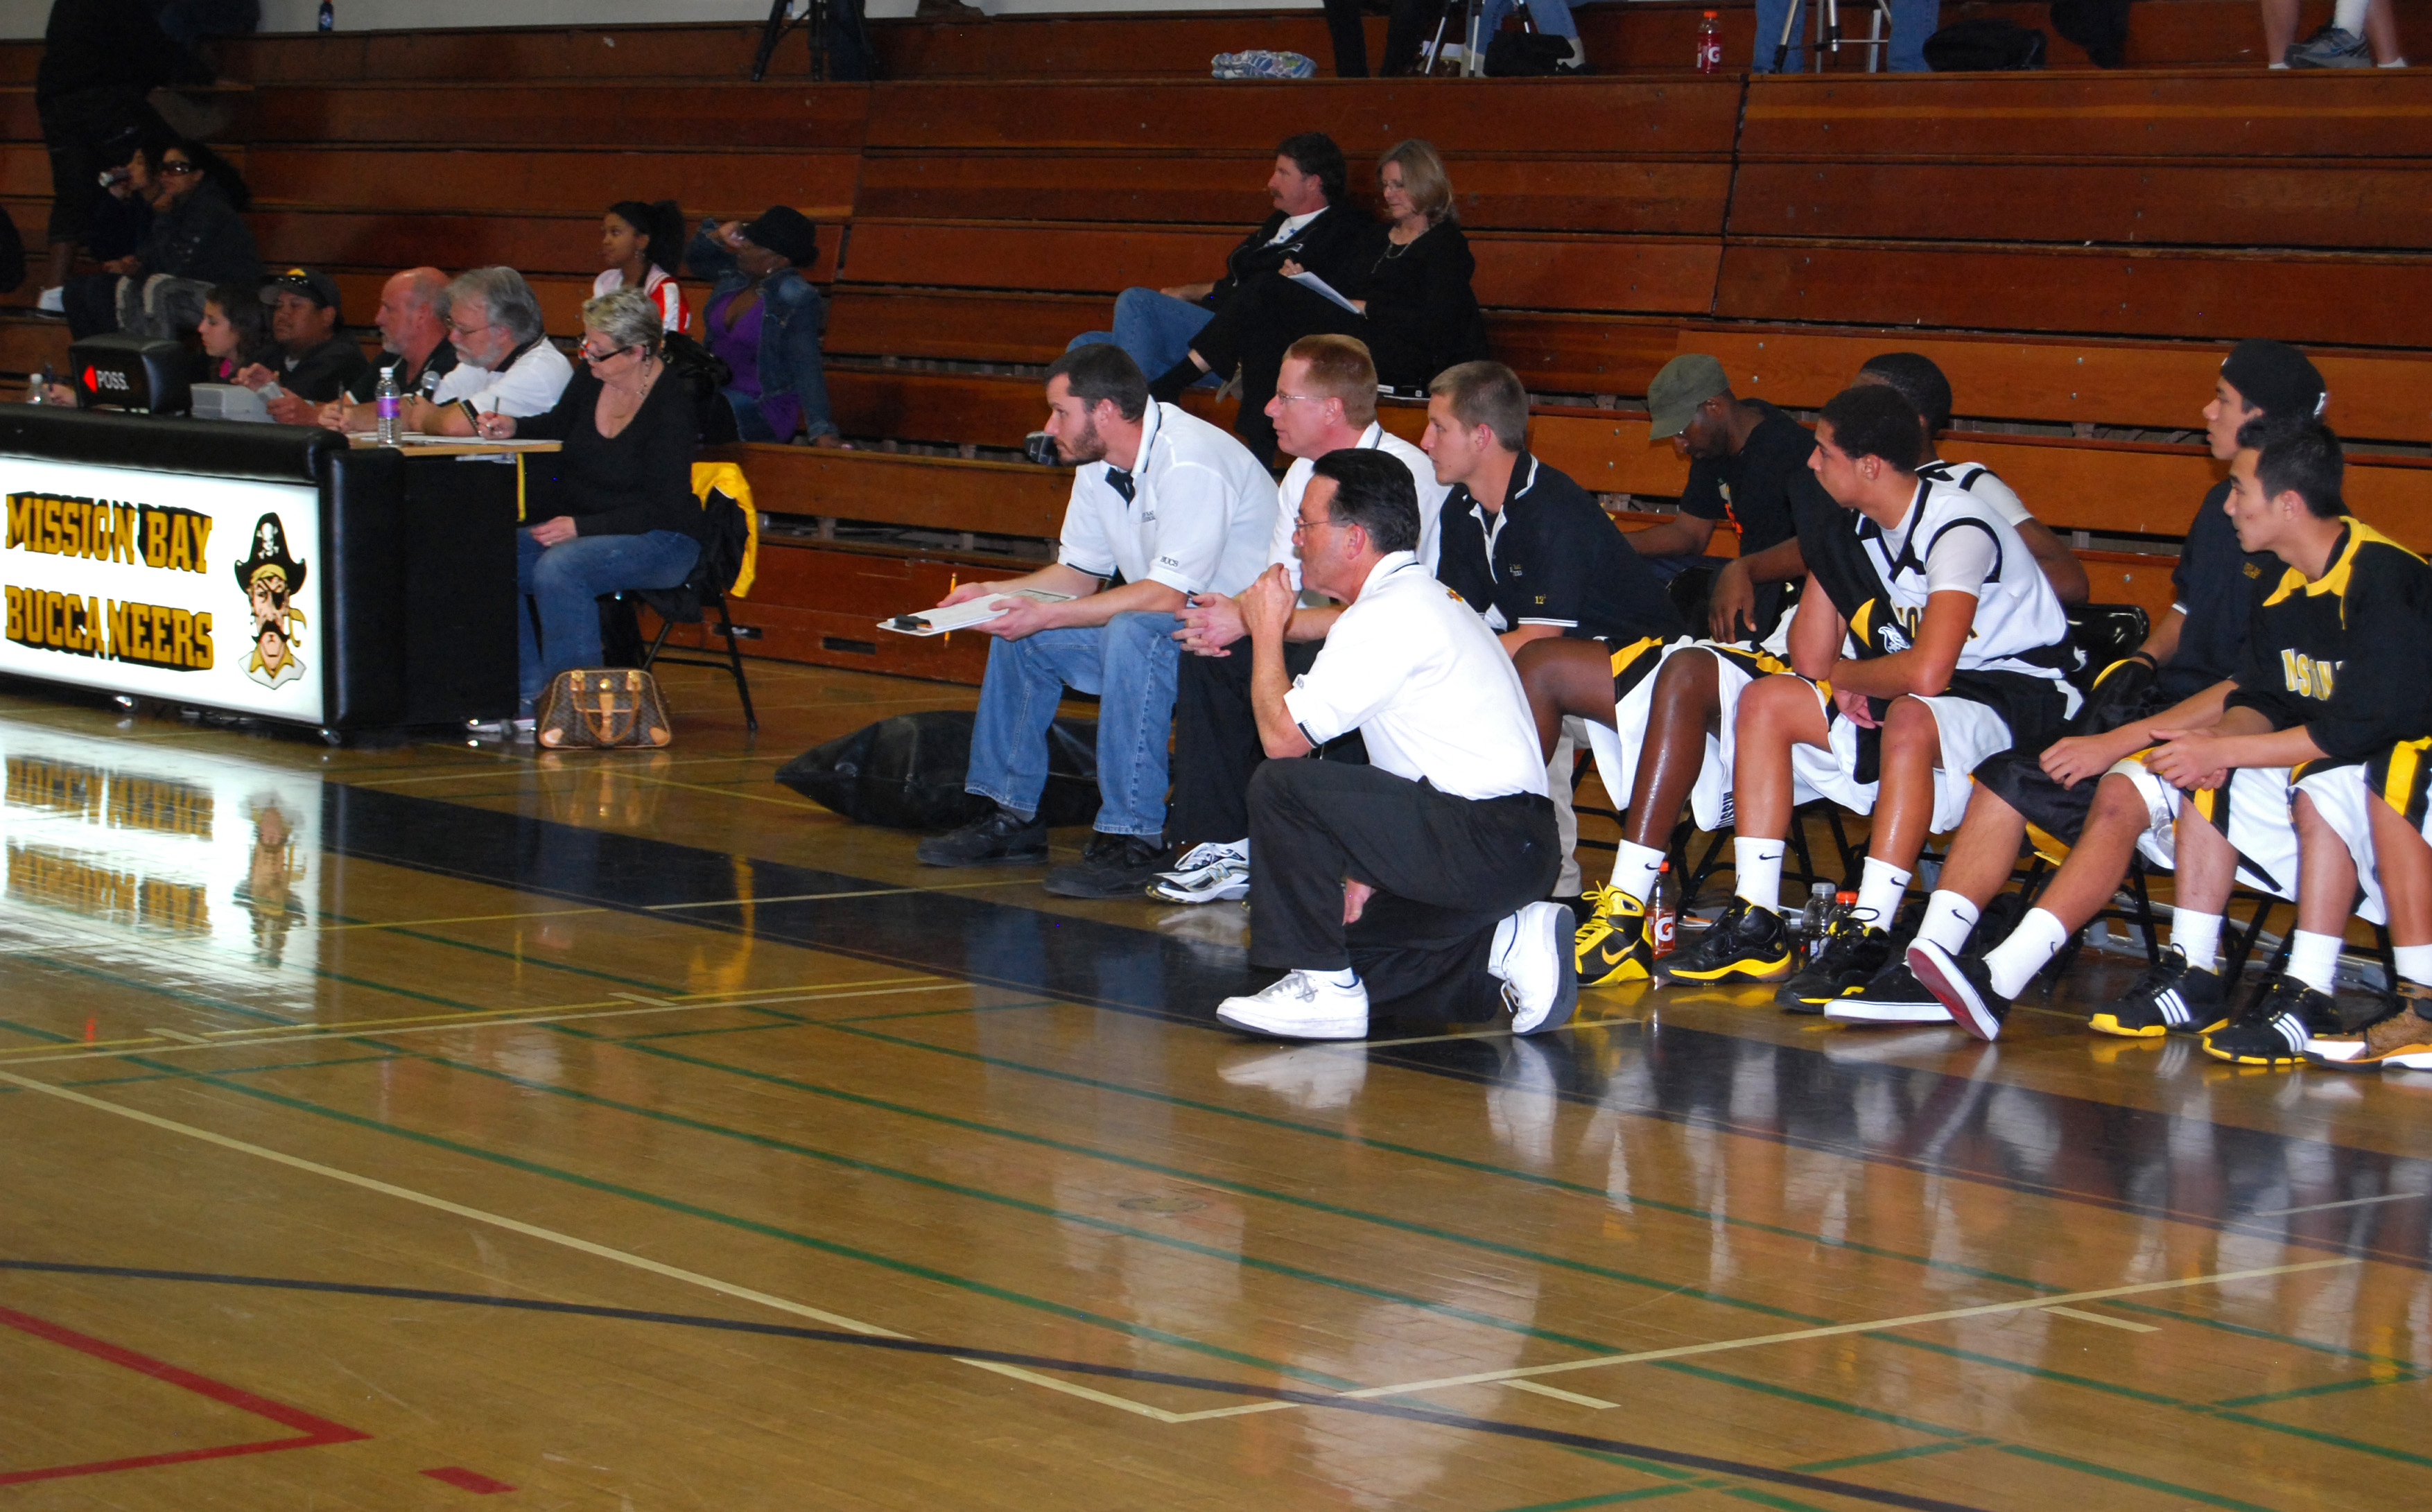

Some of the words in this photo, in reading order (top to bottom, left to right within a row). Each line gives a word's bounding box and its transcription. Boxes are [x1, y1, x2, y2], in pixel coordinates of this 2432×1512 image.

[6, 491, 136, 565] MISSION
[137, 502, 212, 574] BAY
[5, 584, 214, 672] BUCCANEERS
[1654, 916, 1674, 942] G
